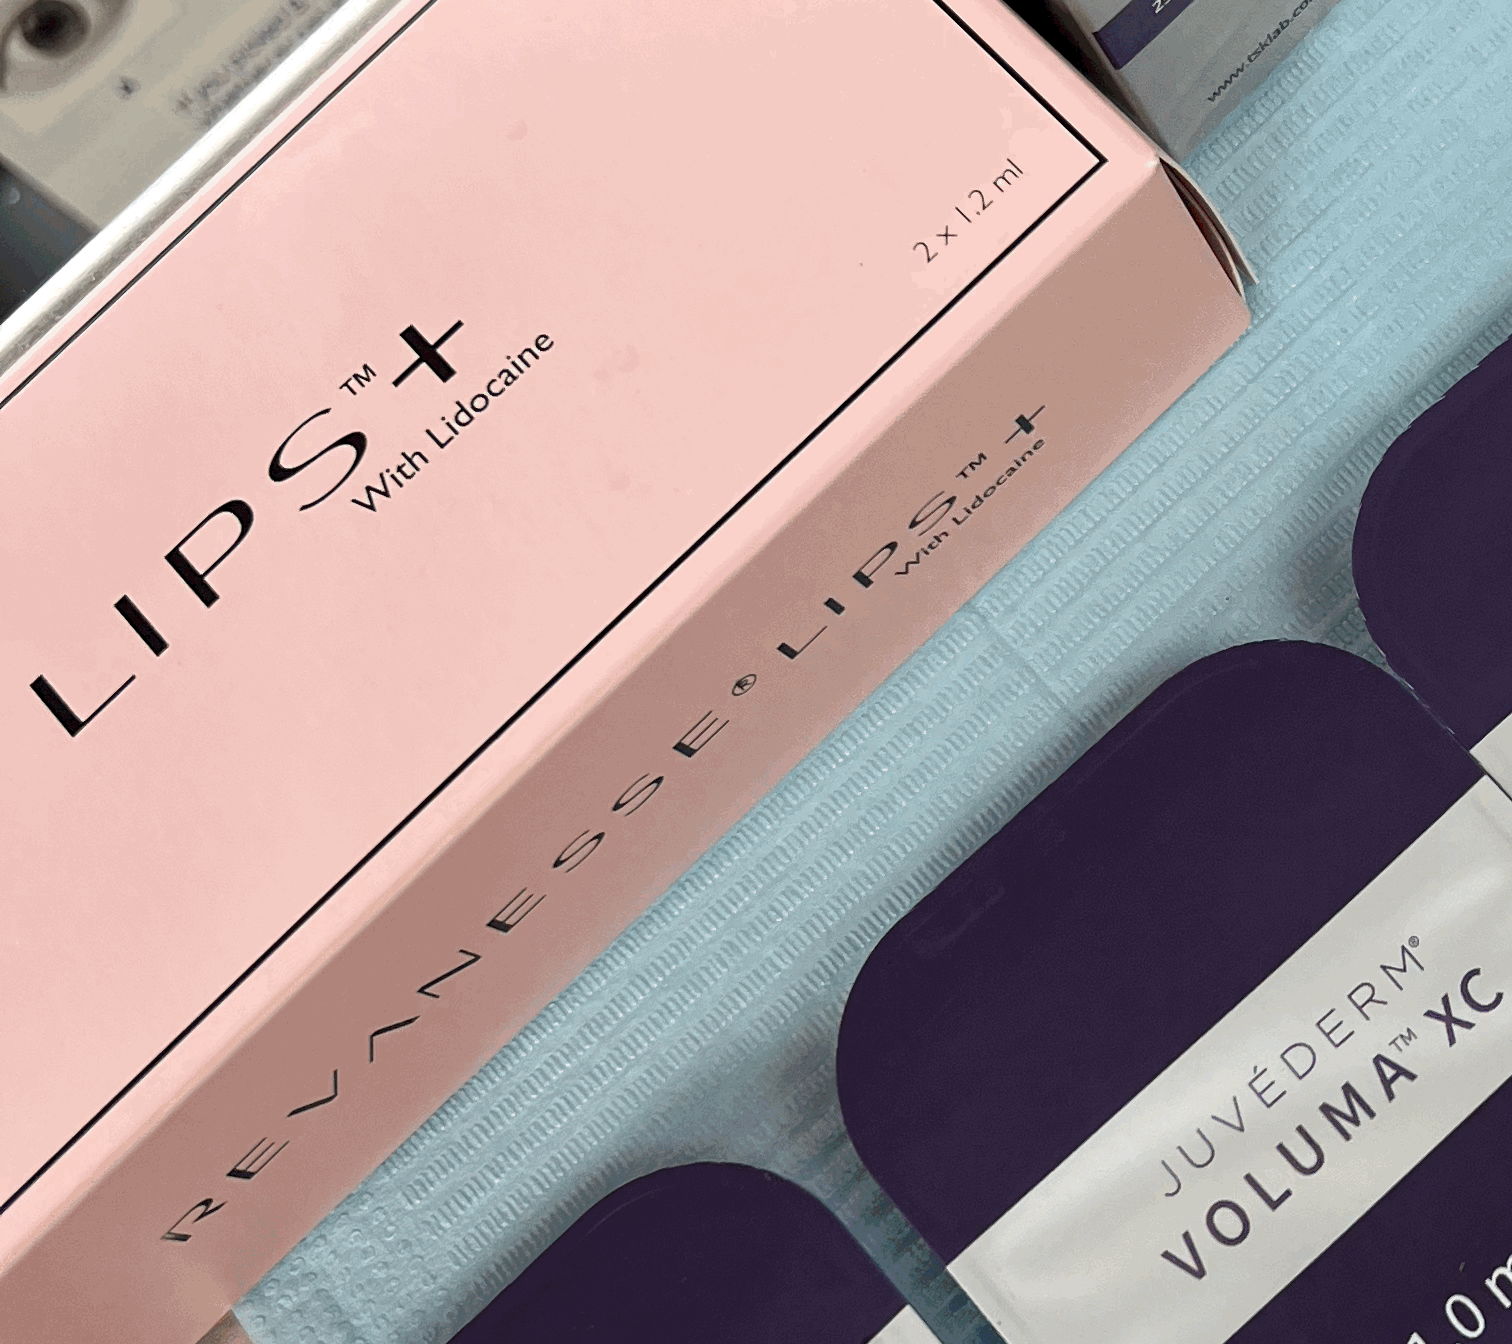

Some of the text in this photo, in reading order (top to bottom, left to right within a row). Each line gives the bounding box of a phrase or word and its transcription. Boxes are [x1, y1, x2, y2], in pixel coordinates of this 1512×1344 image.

[913, 242, 938, 263] 2
[955, 189, 993, 223] 1.2
[993, 158, 1023, 192] ml
[351, 333, 555, 513] With Lidocaine
[895, 440, 1045, 575] With Lidocaine
[1424, 968, 1504, 1046] XC
